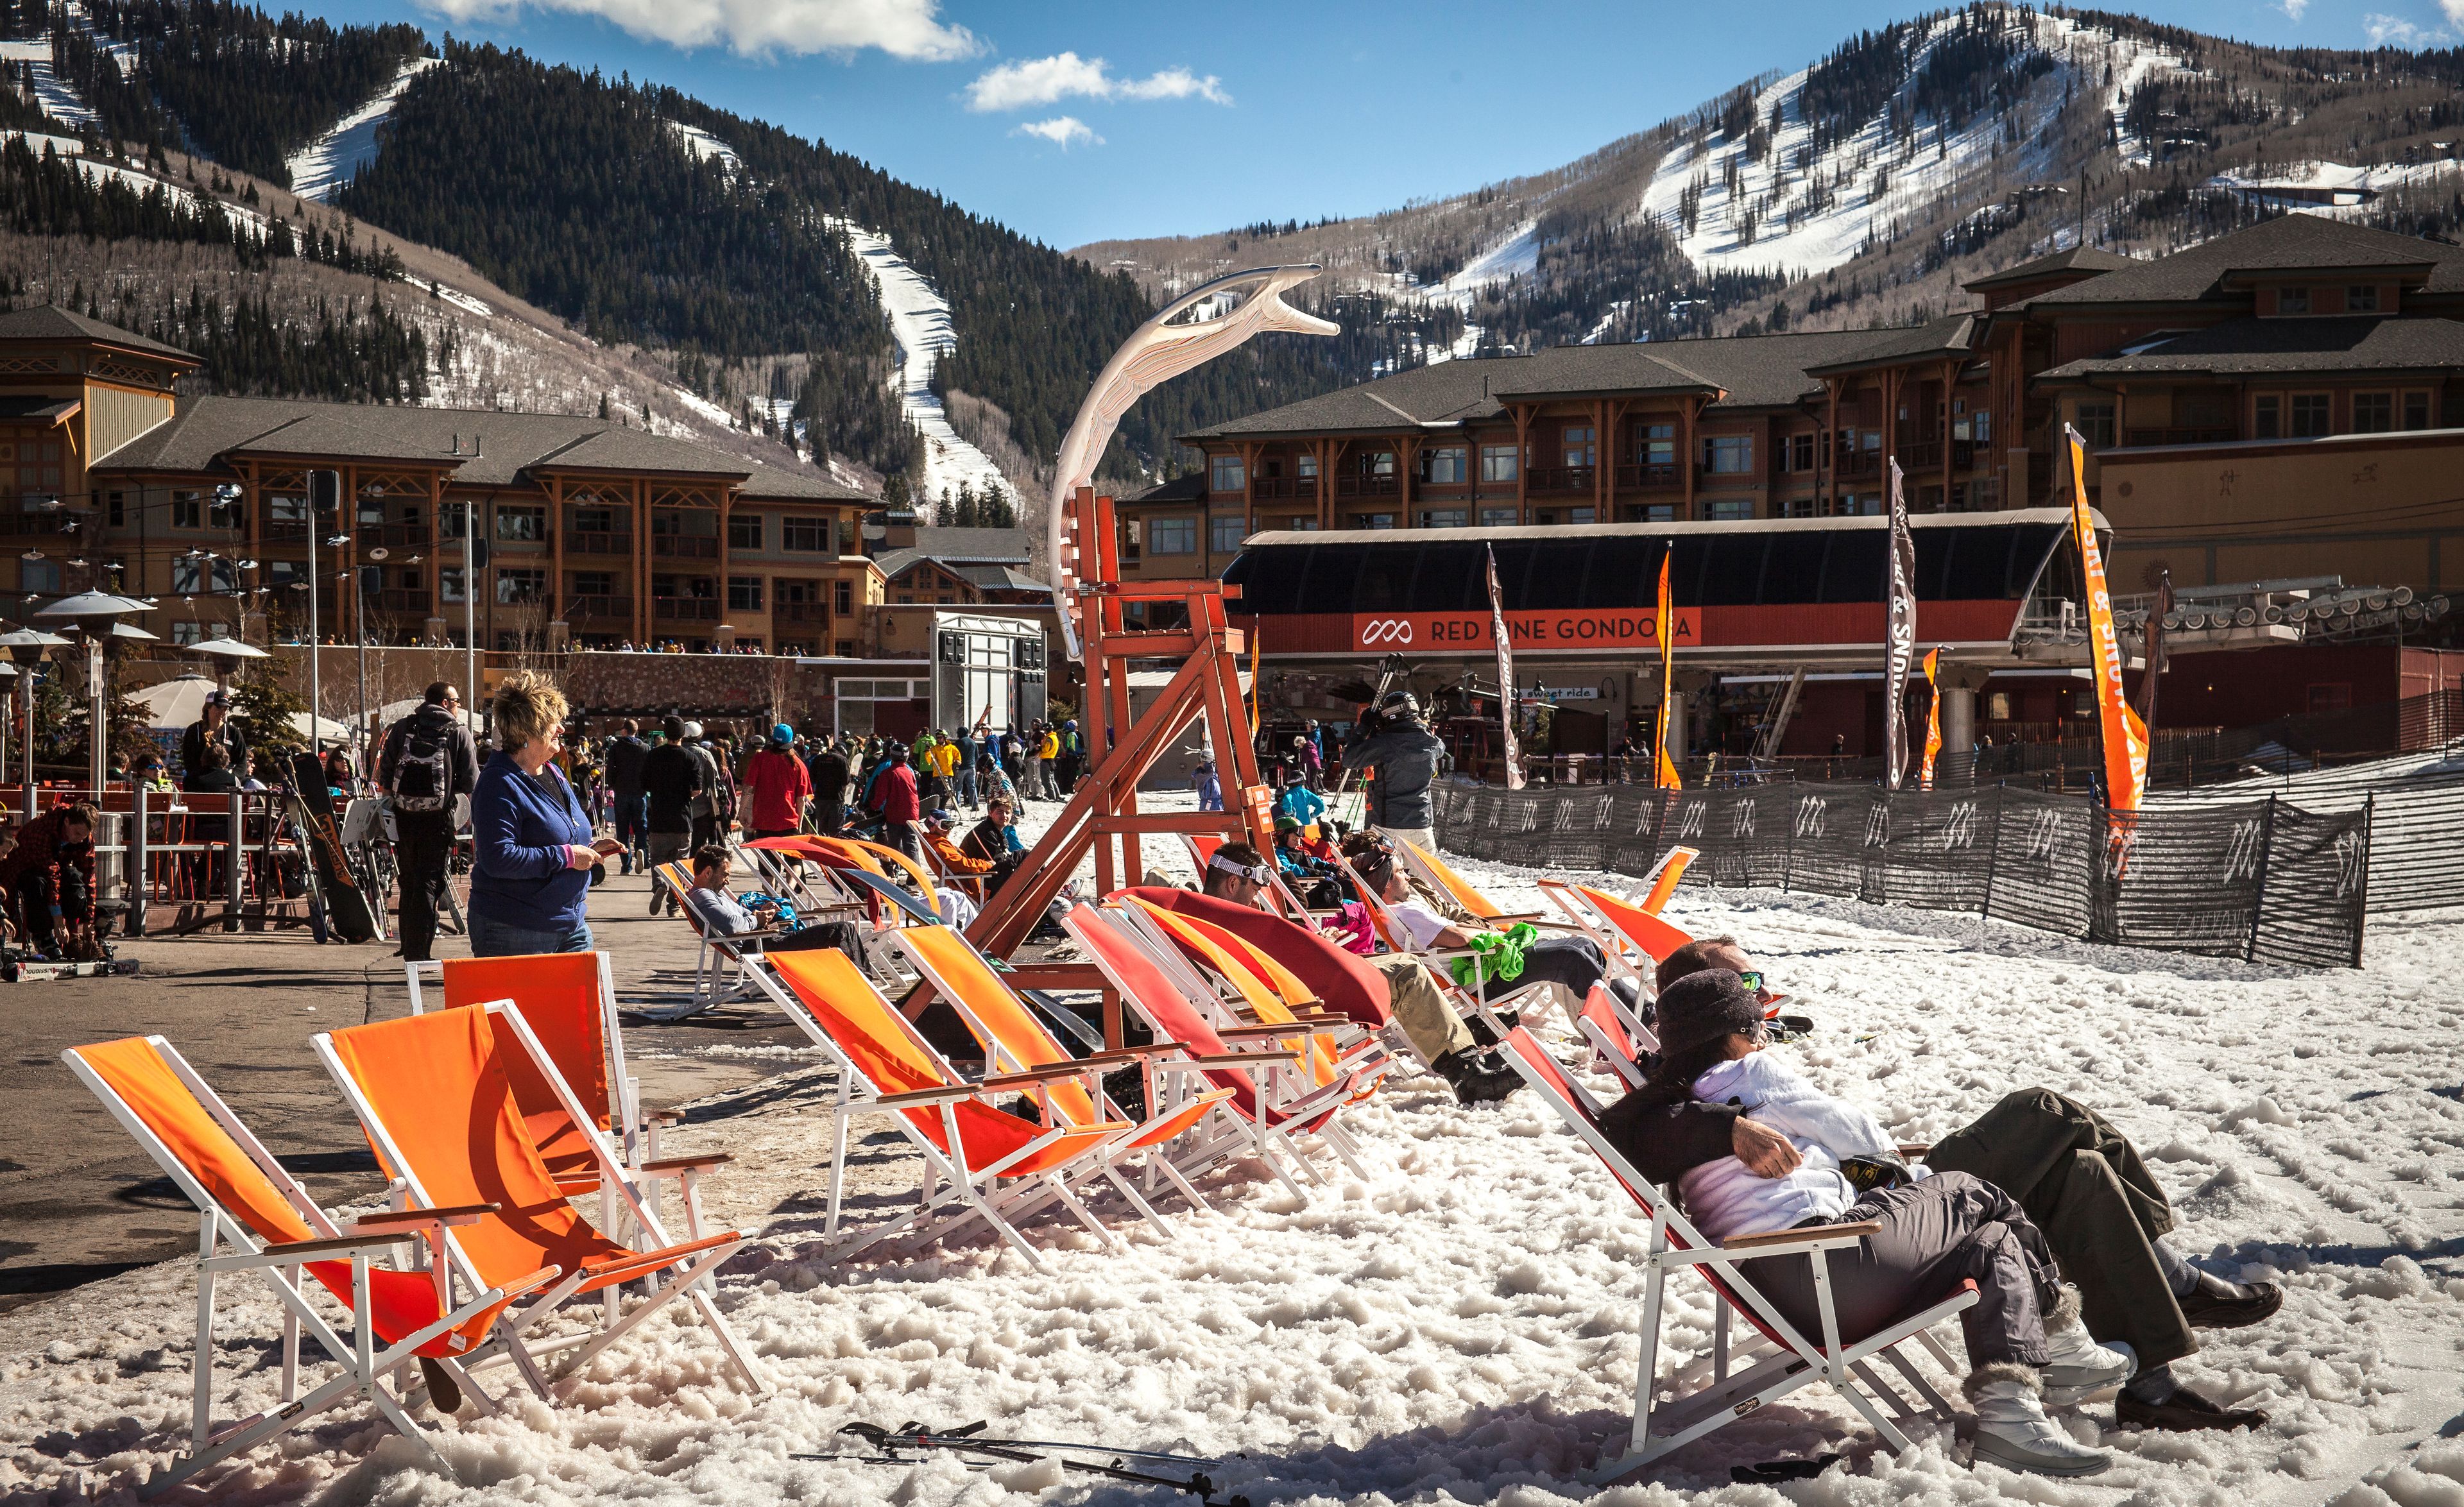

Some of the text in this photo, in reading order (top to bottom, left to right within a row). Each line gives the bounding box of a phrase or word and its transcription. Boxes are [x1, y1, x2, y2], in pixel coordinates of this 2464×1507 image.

[1432, 621, 1480, 640] RED
[1556, 617, 1692, 639] GONDOA
[1566, 687, 1591, 697] ride
